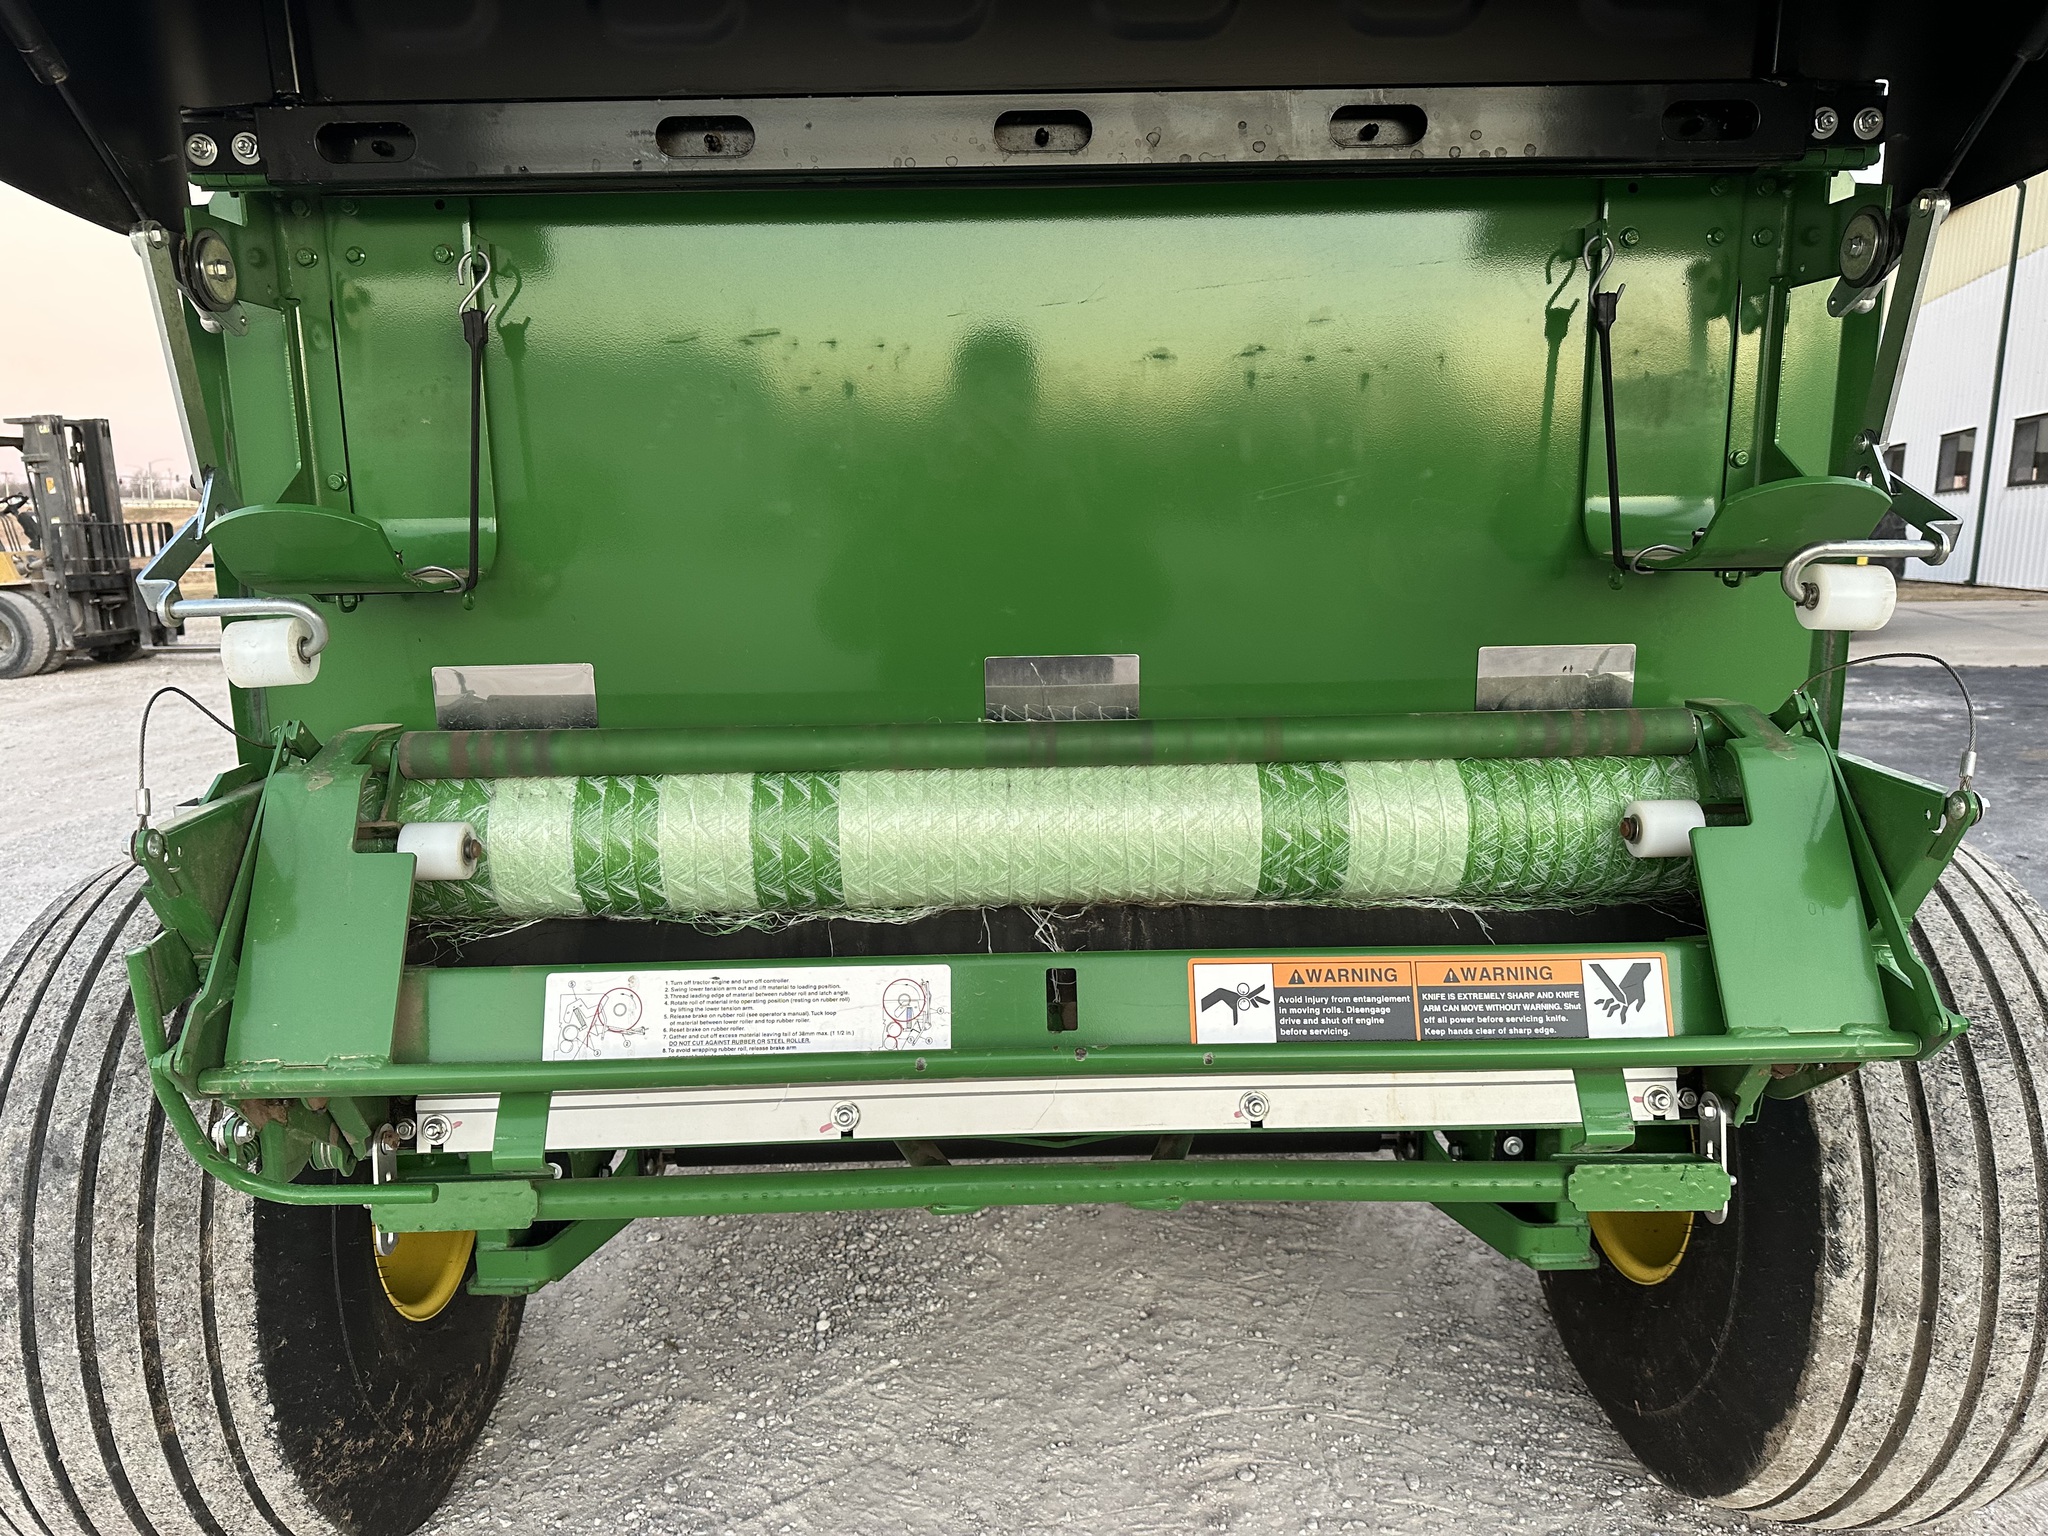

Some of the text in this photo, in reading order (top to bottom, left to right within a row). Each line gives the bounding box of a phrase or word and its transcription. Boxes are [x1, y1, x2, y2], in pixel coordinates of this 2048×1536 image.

[1305, 967, 1398, 983] WARNING
[1460, 966, 1553, 981] WARNING
[1278, 995, 1302, 1003] Avoid
[1304, 995, 1328, 1004] injury
[1352, 994, 1410, 1004] entanglement
[1457, 992, 1505, 1000] EXTREMELY
[1506, 991, 1534, 999] SHARP
[1289, 1006, 1320, 1015] moving
[1346, 1005, 1390, 1015] Disengage
[1484, 1003, 1521, 1011] WITHOUT
[1279, 1016, 1300, 1024] drive
[1320, 1016, 1339, 1024] shut
[1355, 1016, 1384, 1025] engine
[1505, 1014, 1543, 1024] servicing
[1280, 1027, 1350, 1036] before servicing.
[1424, 1027, 1446, 1036] Keep
[1508, 1026, 1532, 1036] sharp
[1534, 1026, 1556, 1035] edge.
